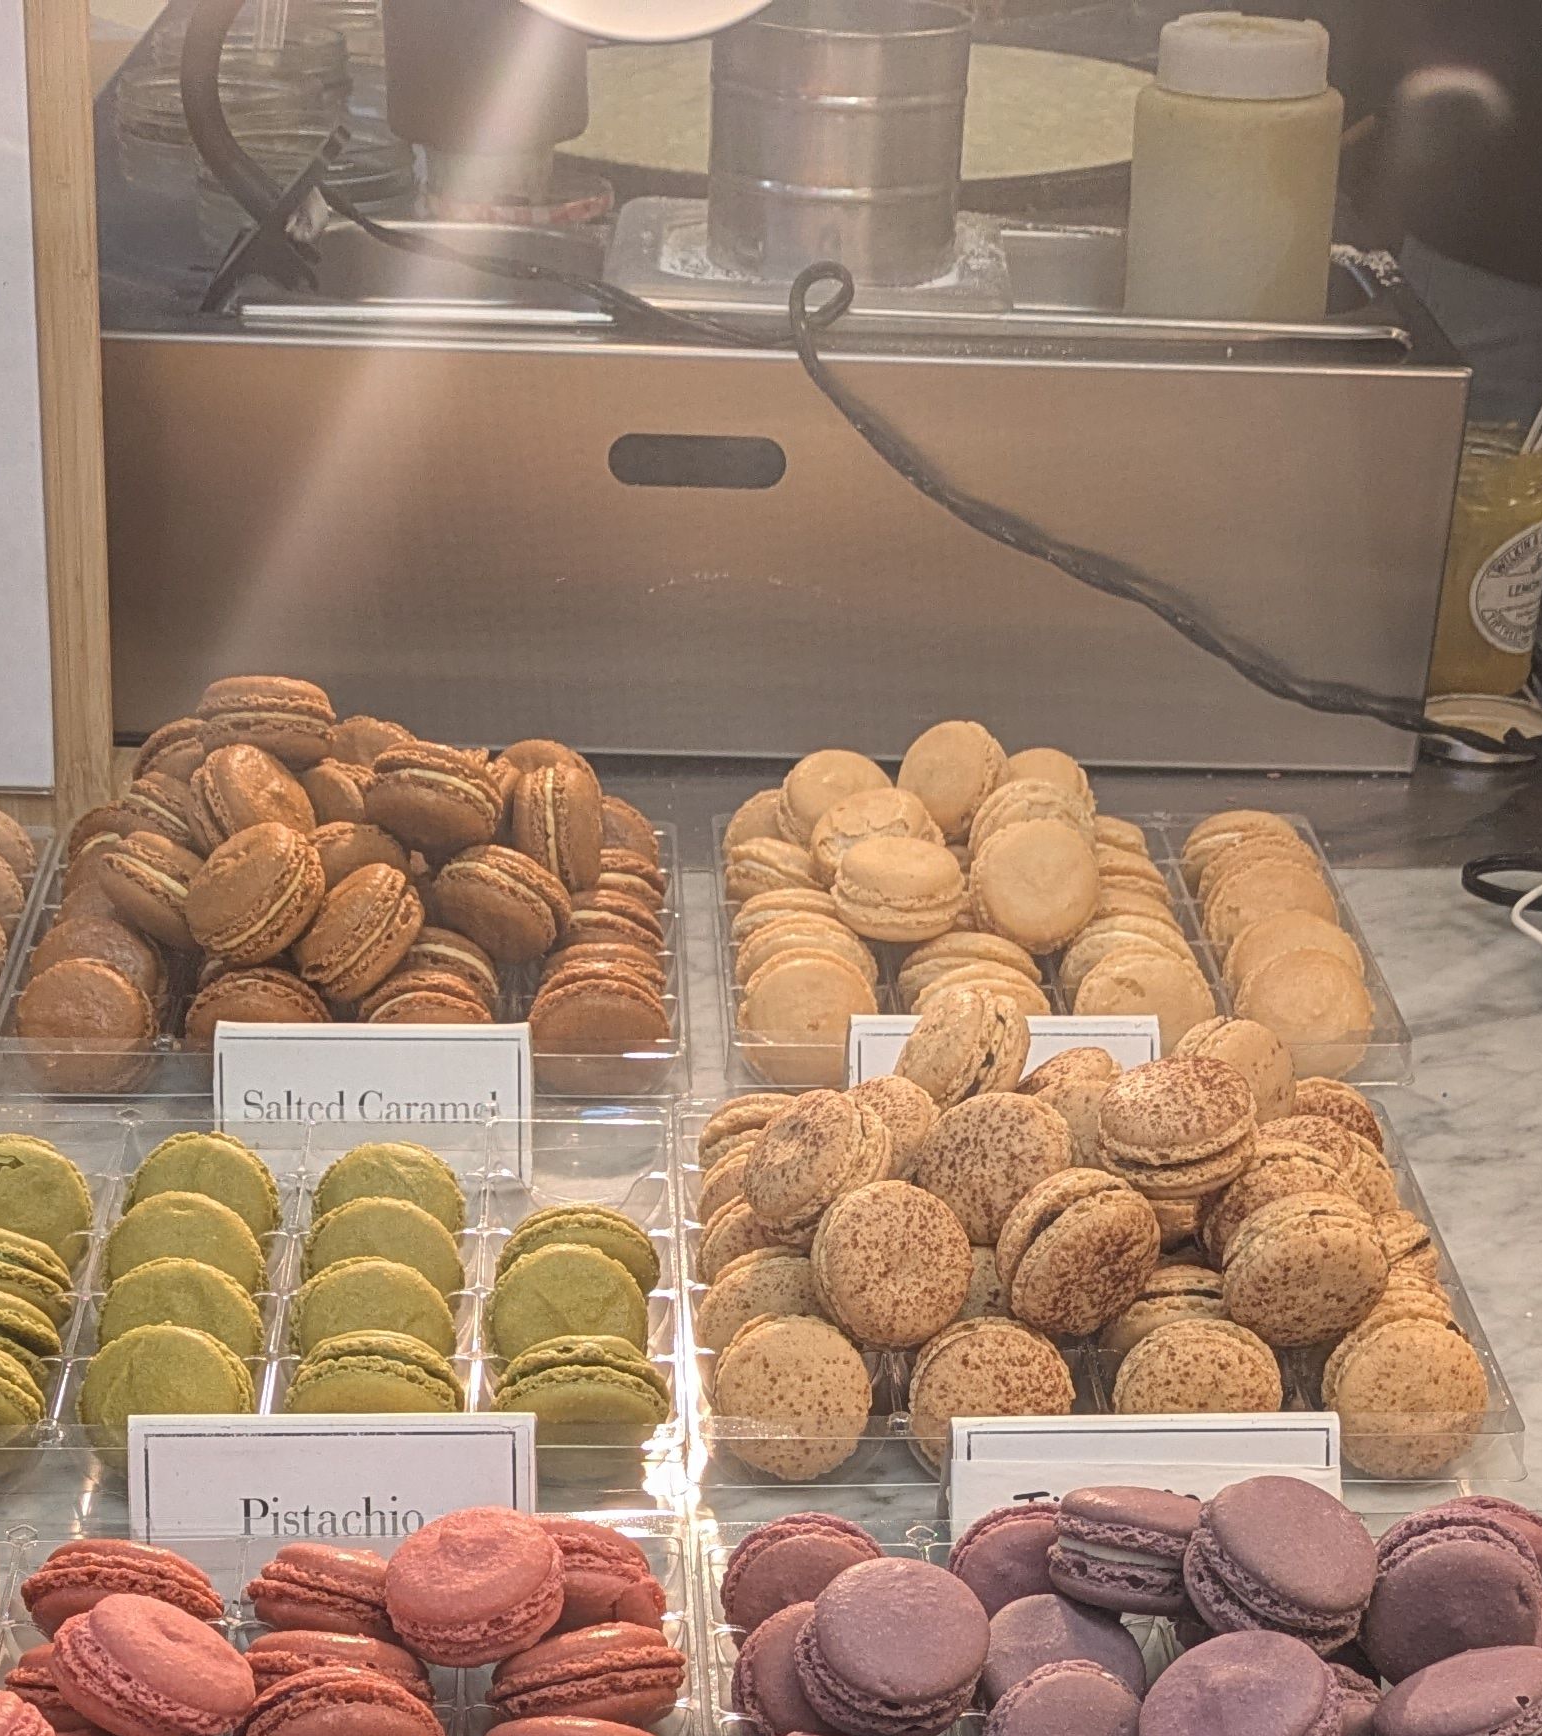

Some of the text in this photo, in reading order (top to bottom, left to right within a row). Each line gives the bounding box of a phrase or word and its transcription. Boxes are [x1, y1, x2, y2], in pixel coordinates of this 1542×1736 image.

[243, 1089, 500, 1126] Salted Caramel
[238, 1495, 425, 1538] Pistachio
